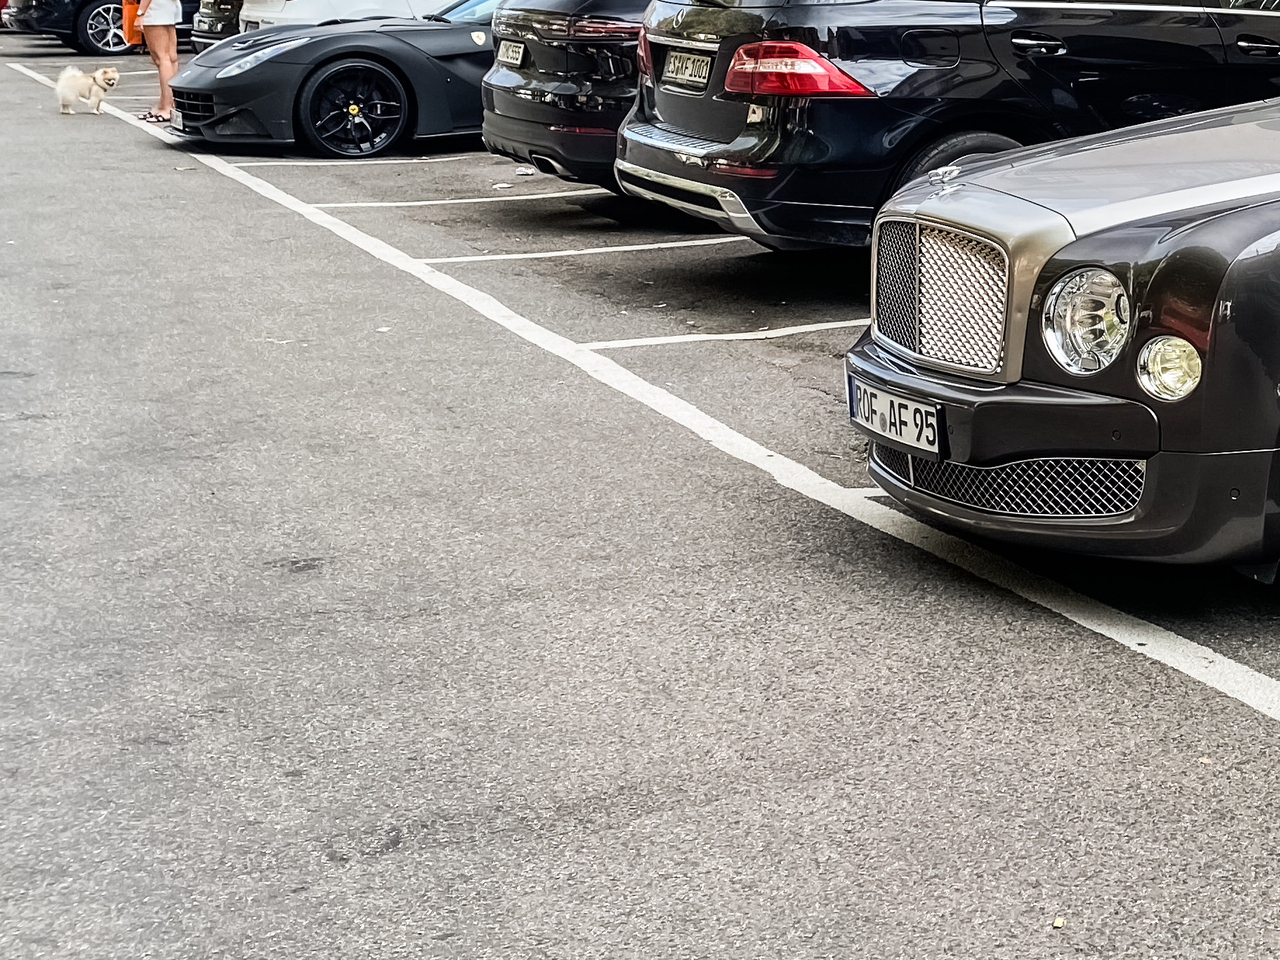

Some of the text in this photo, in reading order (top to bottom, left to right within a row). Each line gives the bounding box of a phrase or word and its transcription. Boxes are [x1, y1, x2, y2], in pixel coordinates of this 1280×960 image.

[689, 58, 709, 79] 1001
[855, 383, 937, 446] ROF AF 95
